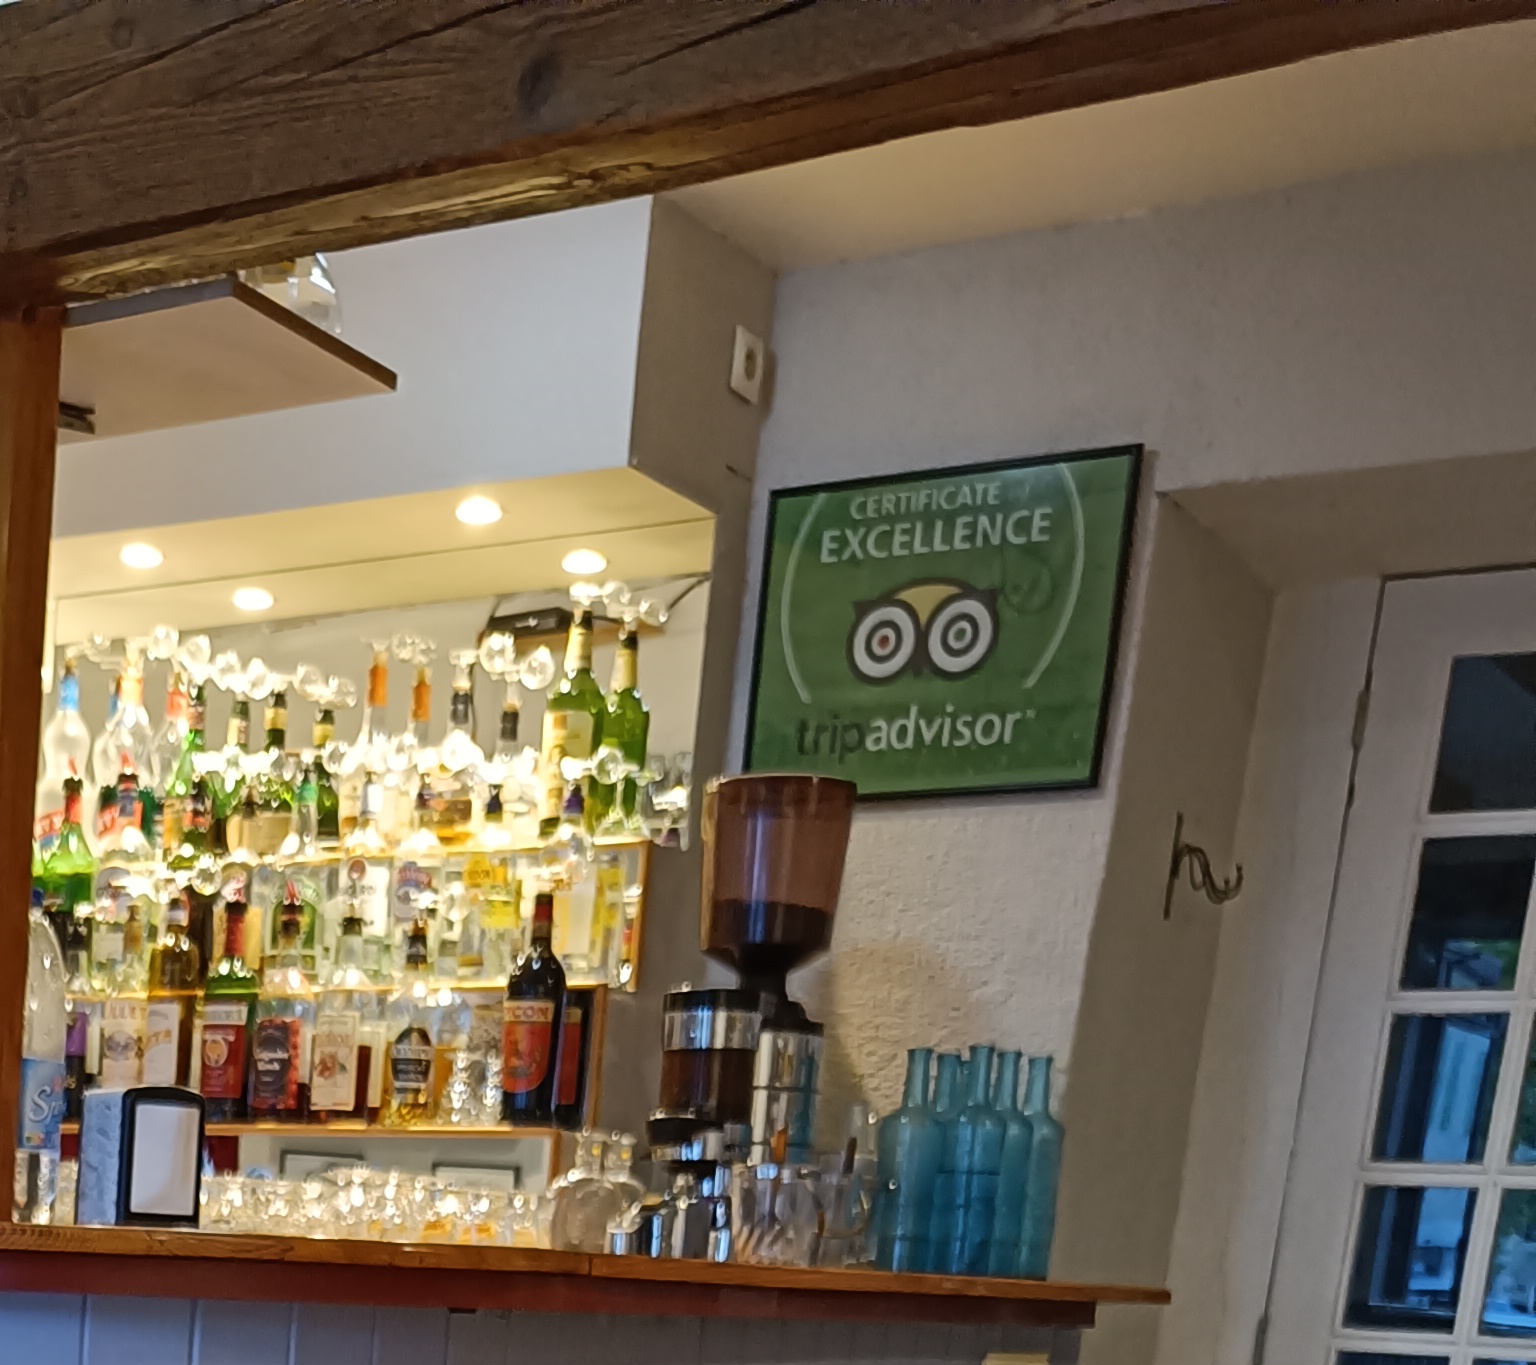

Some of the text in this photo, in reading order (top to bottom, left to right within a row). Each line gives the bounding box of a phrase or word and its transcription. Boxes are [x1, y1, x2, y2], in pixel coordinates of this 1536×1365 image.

[849, 481, 1001, 520] CERTIFICATE
[820, 507, 1053, 563] EXCELLENCE
[797, 703, 1022, 765] tripadvisor
